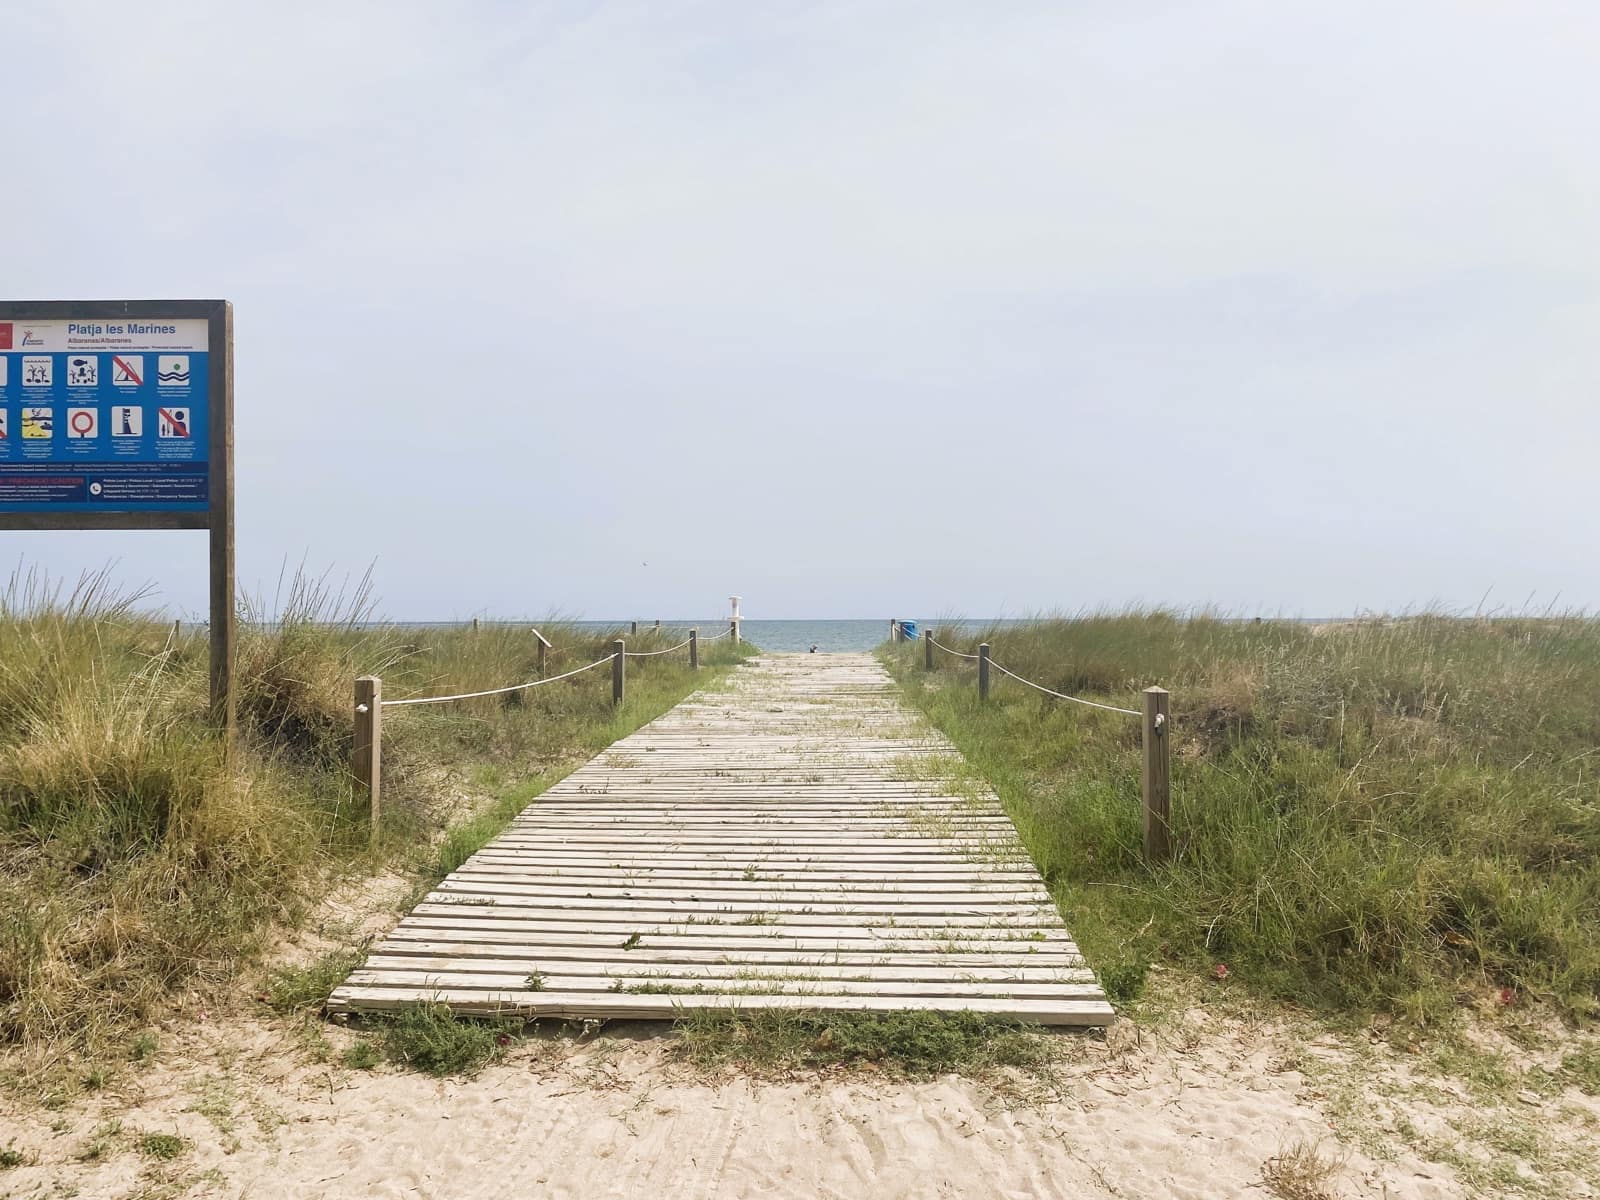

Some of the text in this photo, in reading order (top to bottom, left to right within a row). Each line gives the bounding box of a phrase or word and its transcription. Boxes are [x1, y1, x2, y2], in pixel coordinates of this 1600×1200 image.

[68, 323, 176, 336] Platja les Marines
